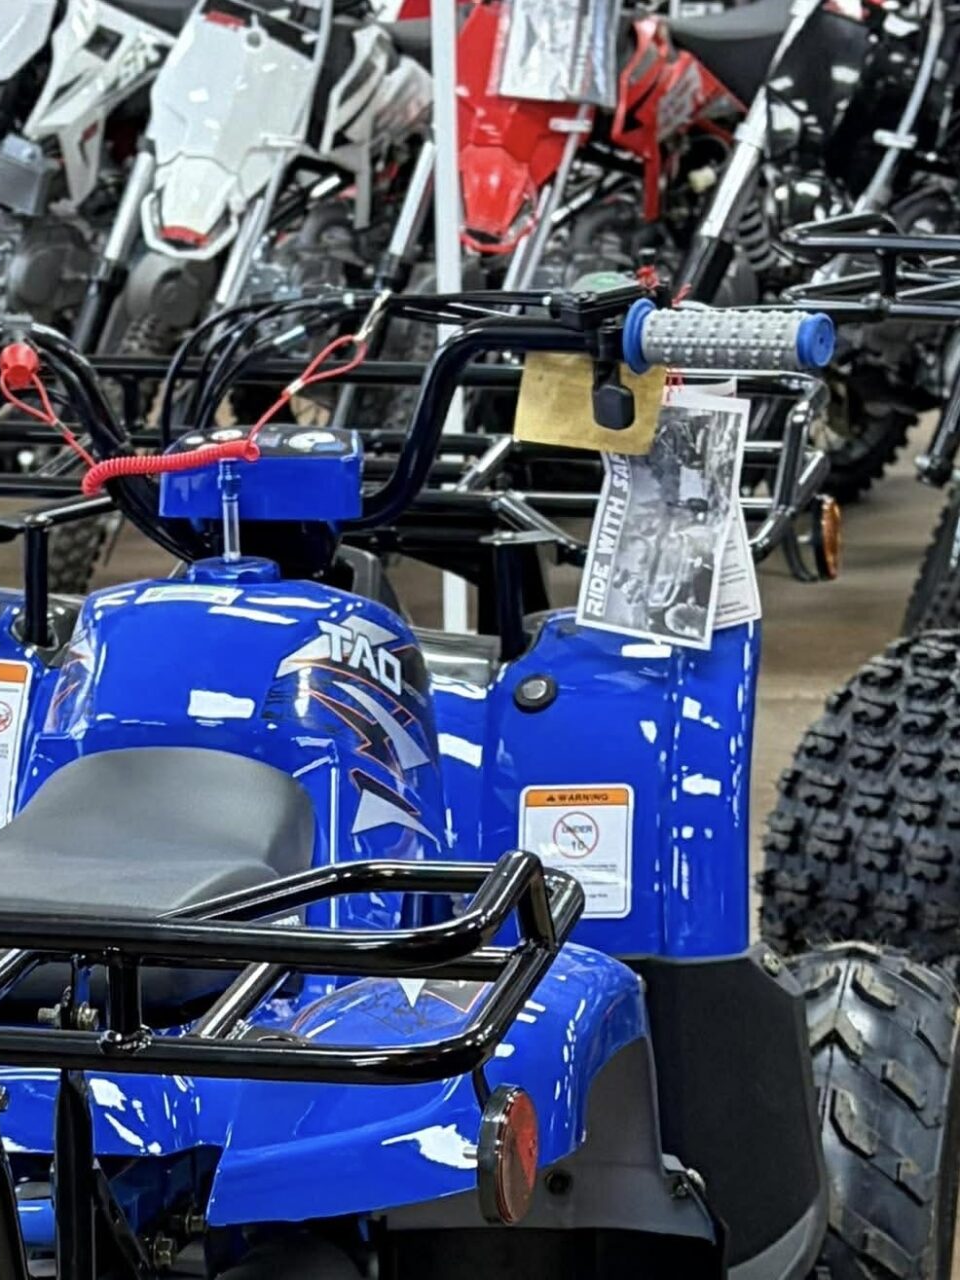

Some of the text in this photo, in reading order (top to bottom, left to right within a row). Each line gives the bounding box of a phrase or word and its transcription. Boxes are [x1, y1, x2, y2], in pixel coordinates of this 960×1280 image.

[596, 499, 626, 552] WITH
[585, 559, 611, 617] RIDE
[317, 620, 402, 695] TAO
[558, 792, 609, 802] WARNING
